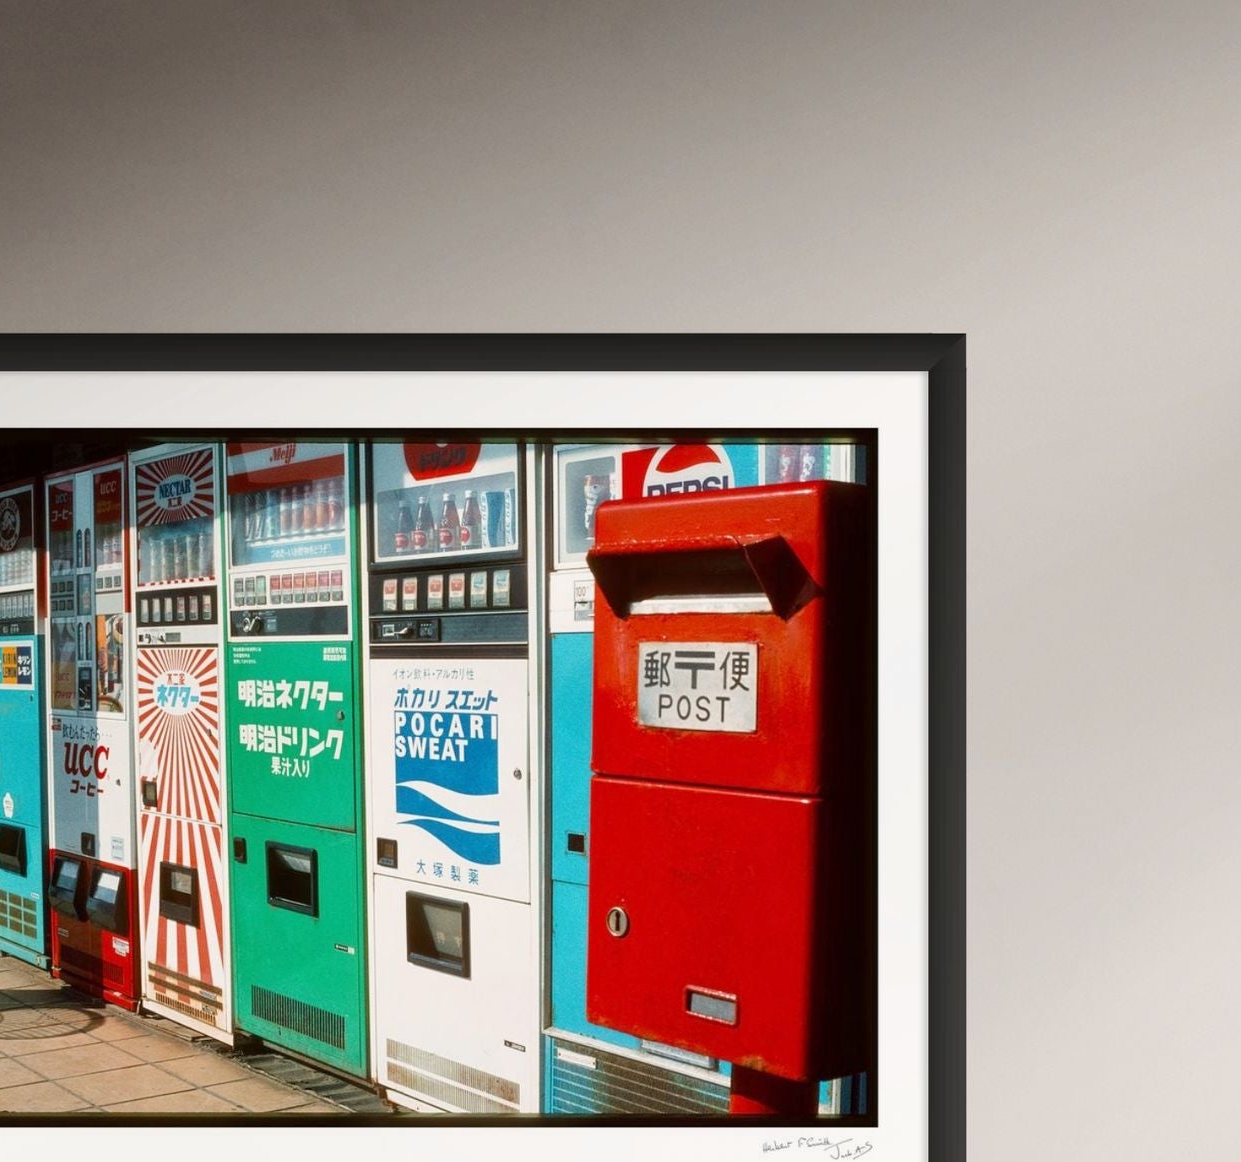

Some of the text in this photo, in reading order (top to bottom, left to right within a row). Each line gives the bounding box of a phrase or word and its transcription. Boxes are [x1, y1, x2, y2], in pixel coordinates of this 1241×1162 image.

[159, 480, 191, 499] NECTAR
[157, 684, 199, 708] ネクター
[238, 680, 343, 711] 明治ネクター
[658, 695, 730, 723] POST
[395, 712, 498, 740] POCARI
[239, 724, 344, 760] 明治ドリンク
[395, 735, 469, 762] SWEAT
[271, 756, 310, 778] 果汁入り
[70, 780, 104, 797] コーヒー
[417, 859, 479, 885] 大塚製薬
